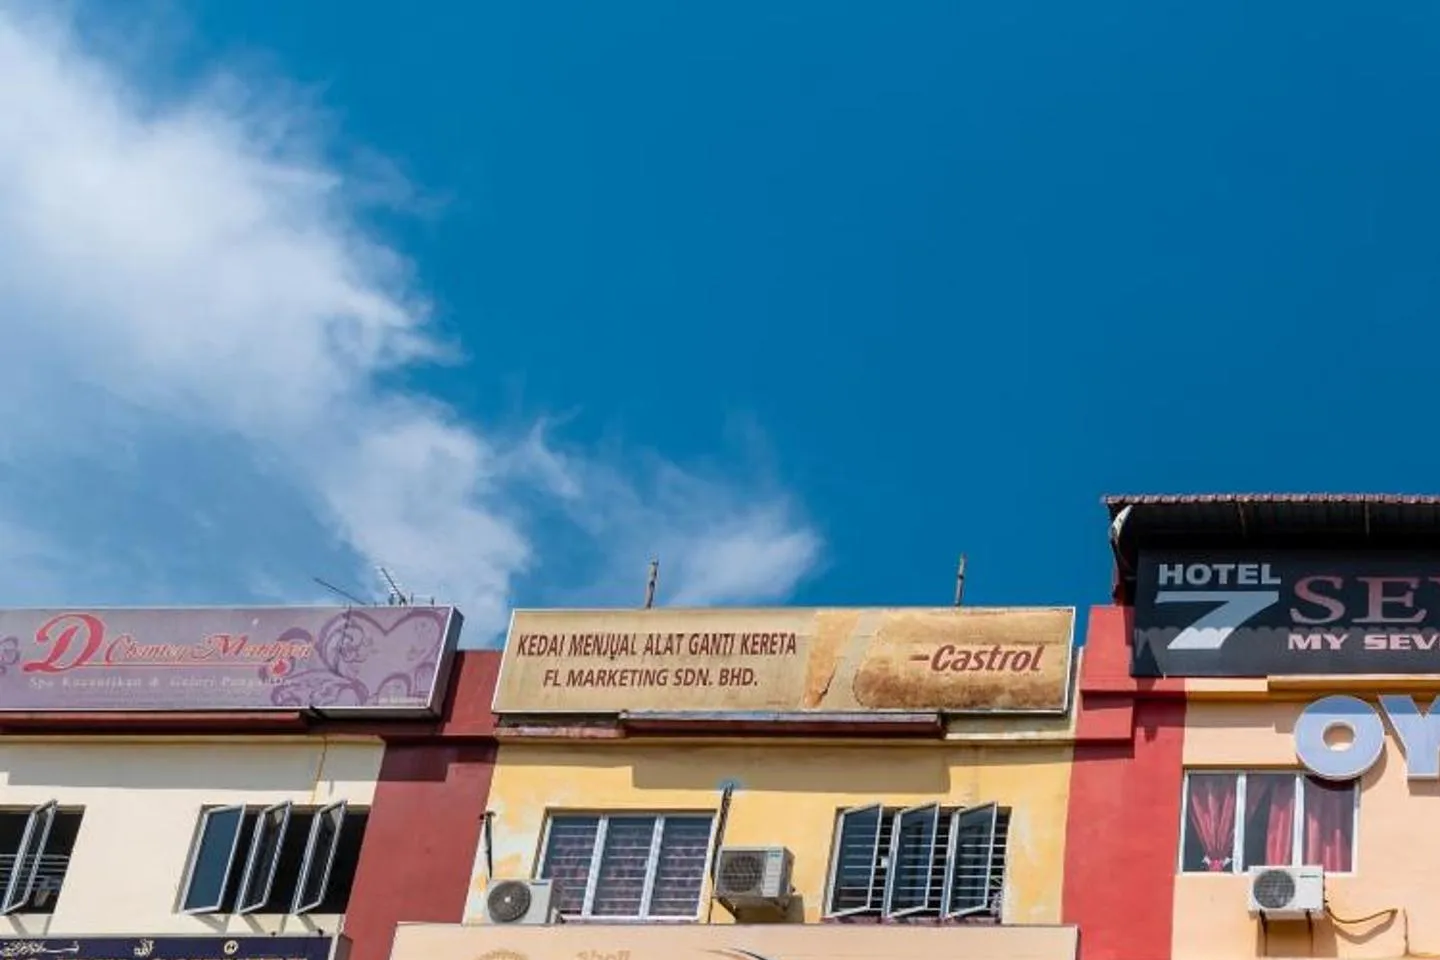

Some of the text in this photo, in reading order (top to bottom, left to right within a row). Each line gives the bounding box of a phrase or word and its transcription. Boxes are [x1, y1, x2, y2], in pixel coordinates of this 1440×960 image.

[1158, 563, 1281, 585] HOTEL
[1154, 590, 1279, 651] 7
[517, 632, 798, 657] KEDAI MENJUAL ALAT GANTI KERETA
[1287, 633, 1349, 651] MY
[931, 644, 1045, 672] Castrol
[543, 668, 758, 687] FL MARKETING SDN. BHD.
